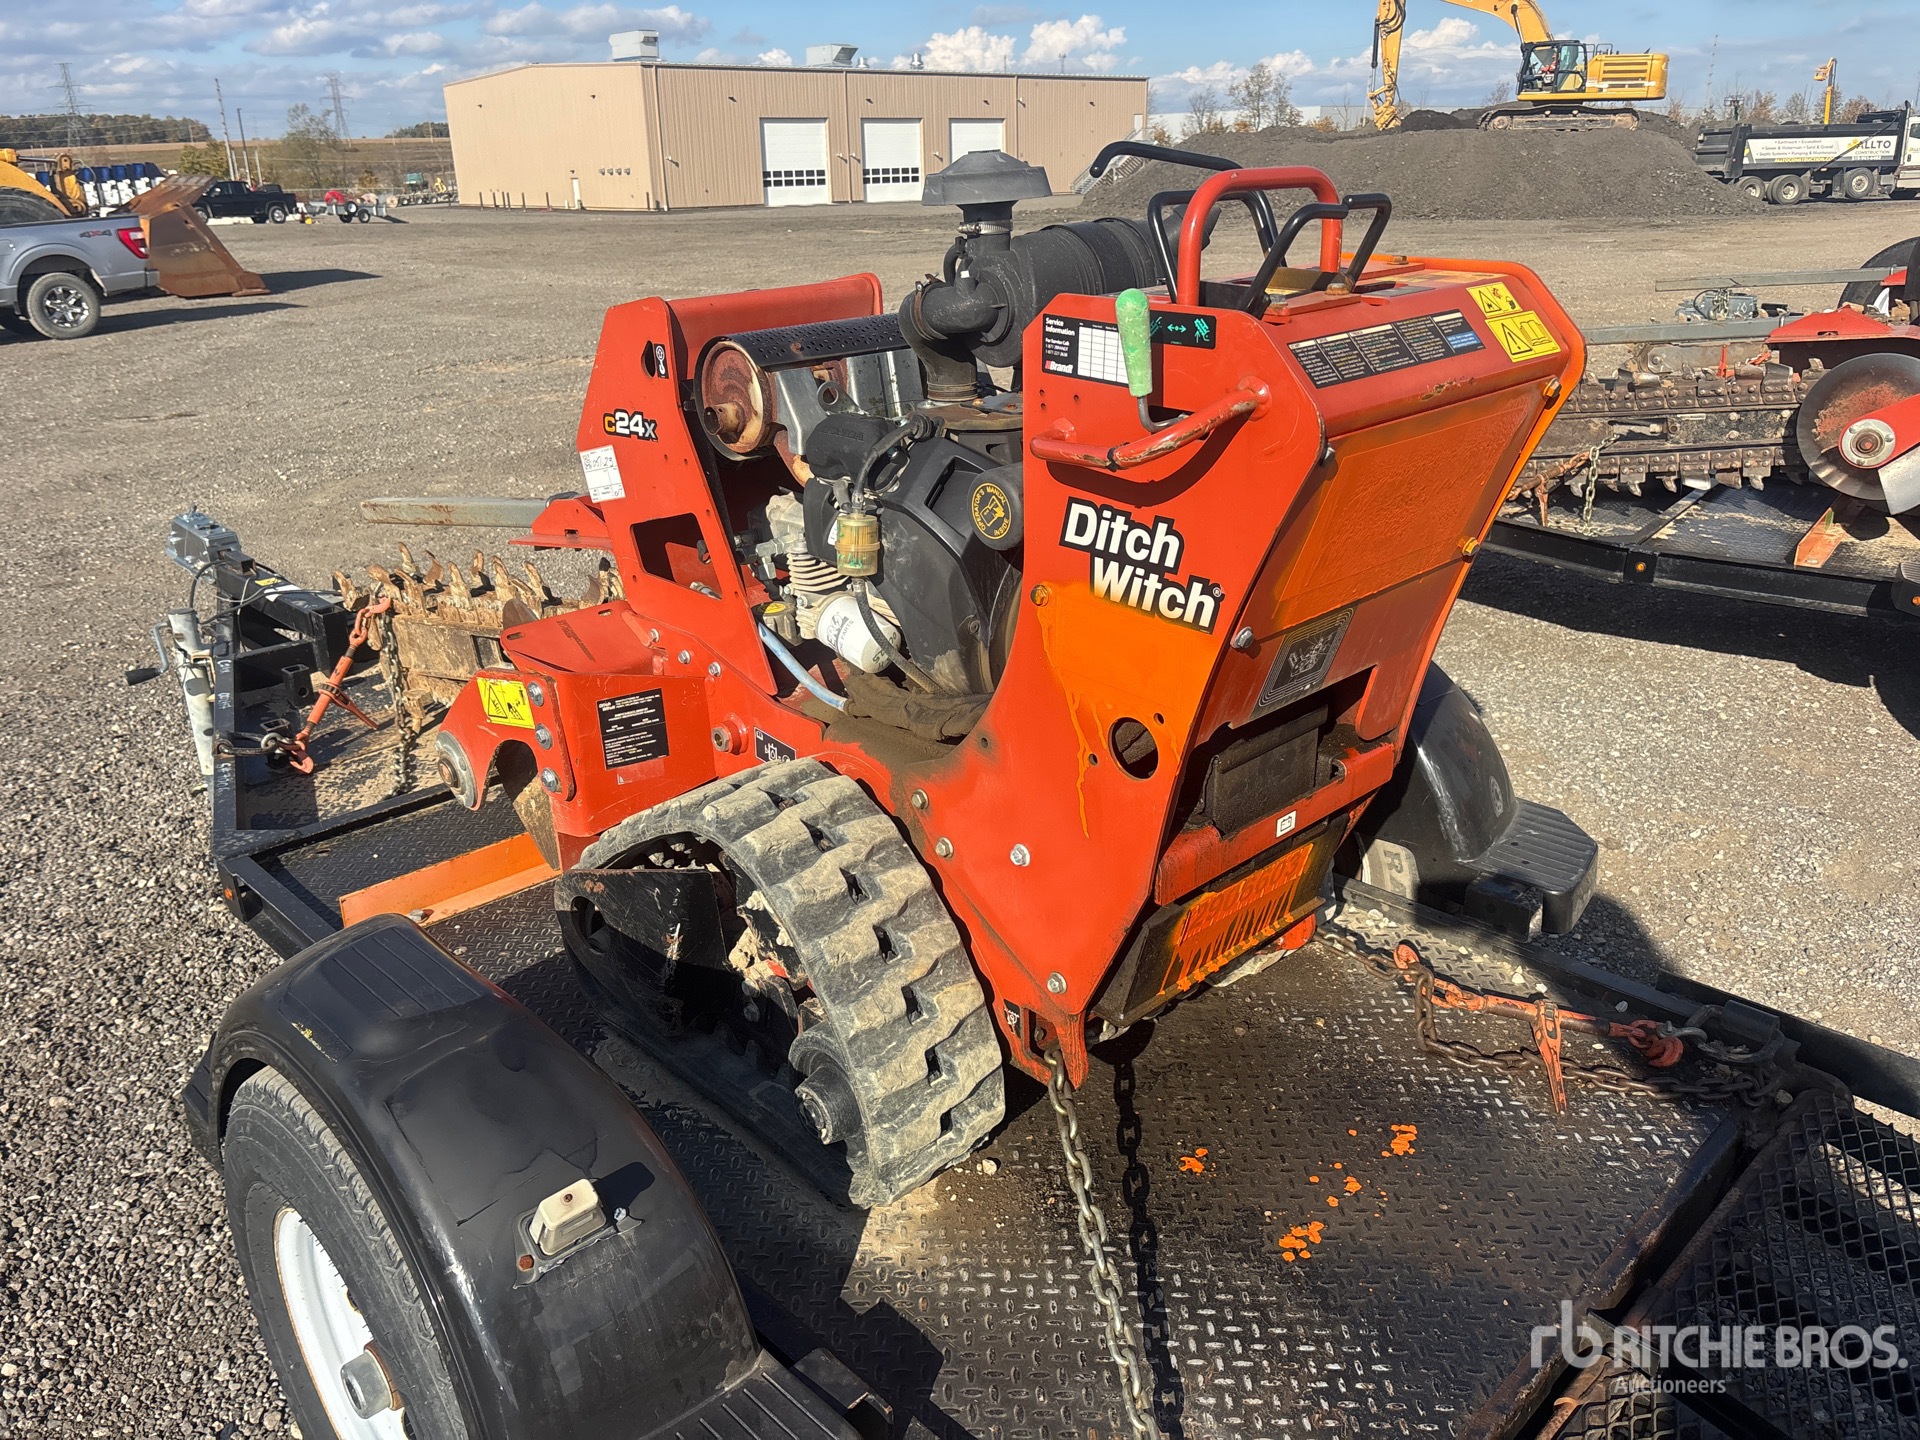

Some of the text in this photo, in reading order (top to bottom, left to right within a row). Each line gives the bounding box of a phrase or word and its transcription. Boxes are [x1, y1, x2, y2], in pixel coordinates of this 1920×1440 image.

[1045, 317, 1064, 327] Service
[1045, 325, 1076, 336] Information
[1049, 360, 1074, 374] Brandt
[986, 486, 1006, 506] MANUAL
[993, 517, 1010, 536] INSIDE
[1064, 502, 1180, 568] Ditch
[841, 620, 854, 640] PARTS
